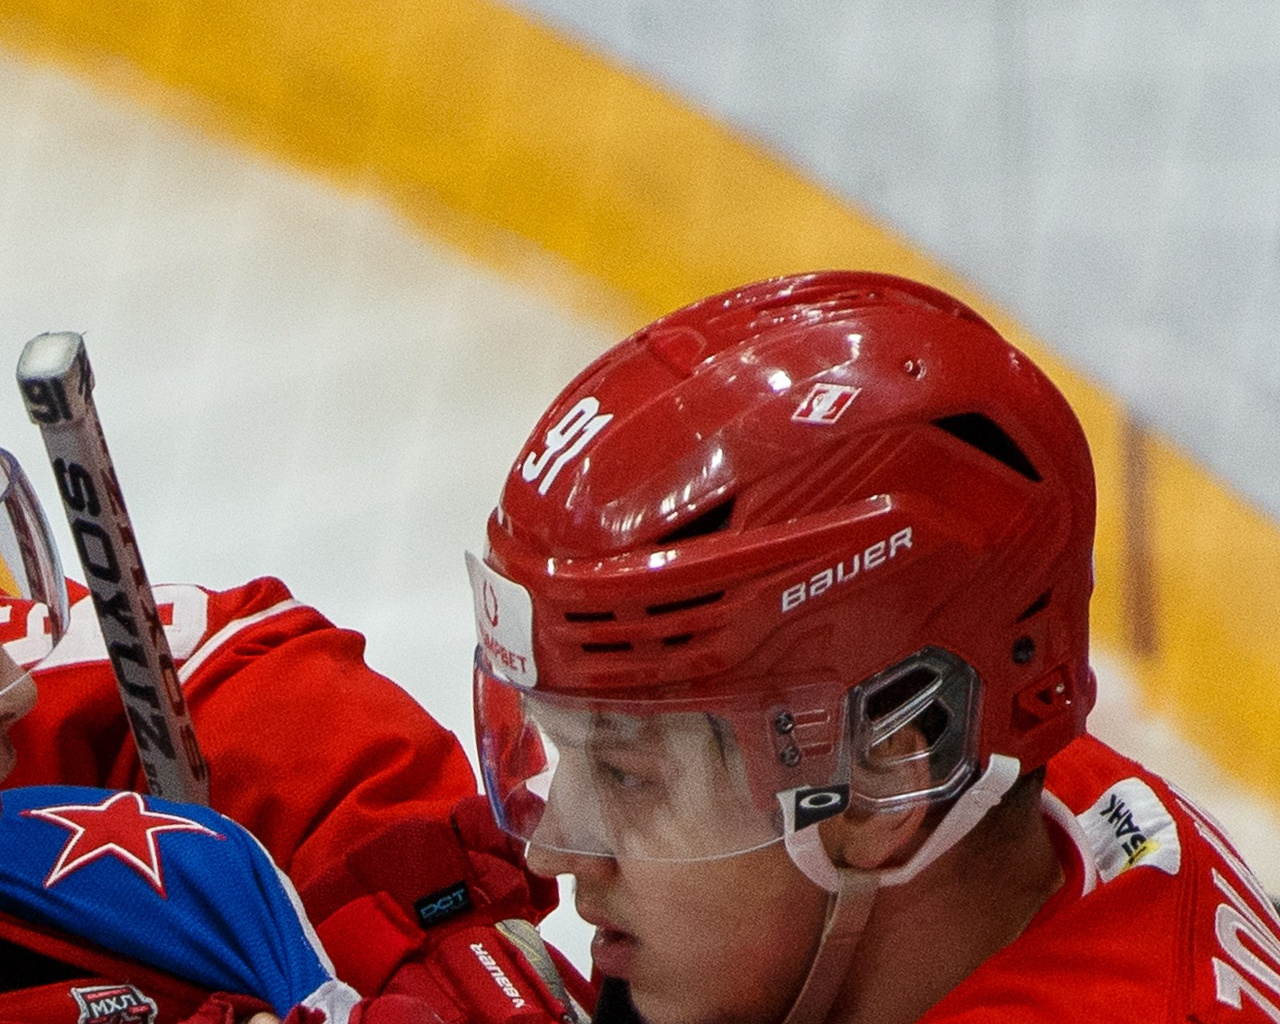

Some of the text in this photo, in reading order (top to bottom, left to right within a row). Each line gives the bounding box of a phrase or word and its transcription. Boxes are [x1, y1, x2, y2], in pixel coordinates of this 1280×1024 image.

[522, 396, 614, 496] 91
[54, 457, 177, 761] SOYUZ
[90, 994, 138, 1018] МХЛ
